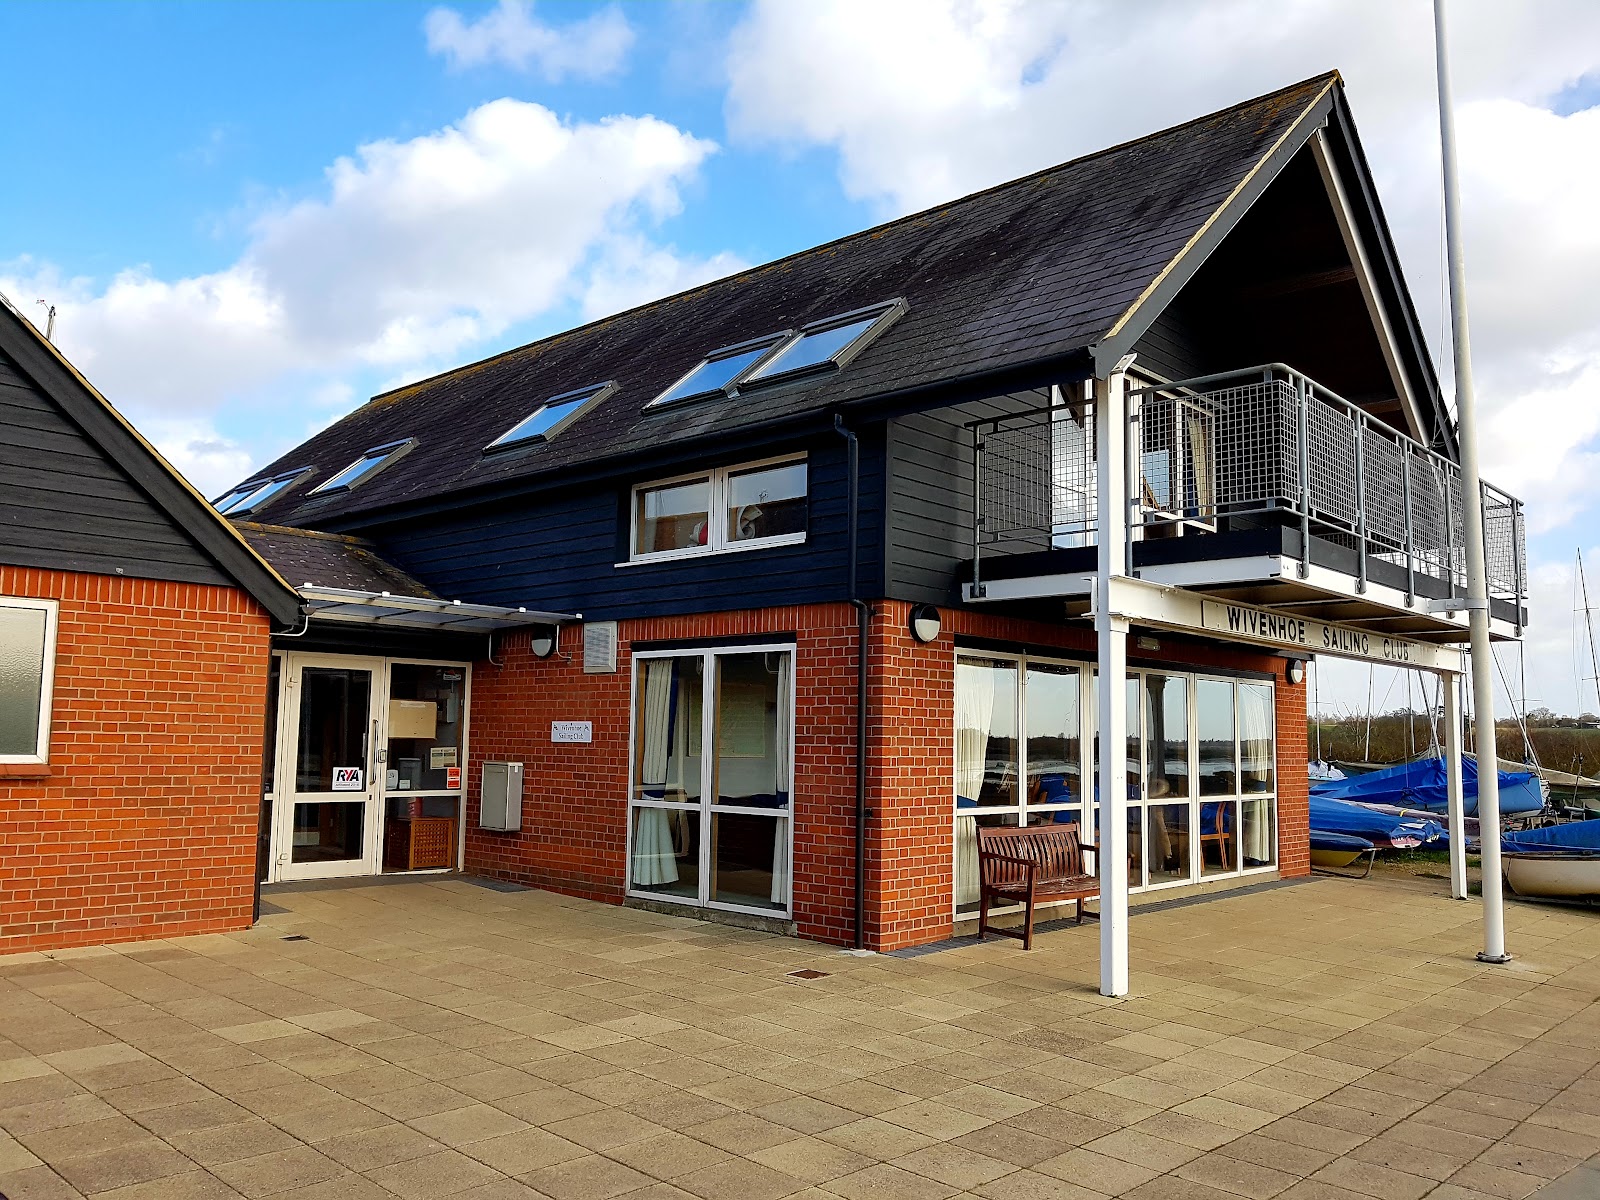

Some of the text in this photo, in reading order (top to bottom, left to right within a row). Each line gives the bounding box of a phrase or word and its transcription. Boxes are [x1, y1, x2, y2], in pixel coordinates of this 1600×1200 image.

[1226, 606, 1409, 661] WIVENHOE SAILING CLUB
[336, 769, 360, 782] RYA
